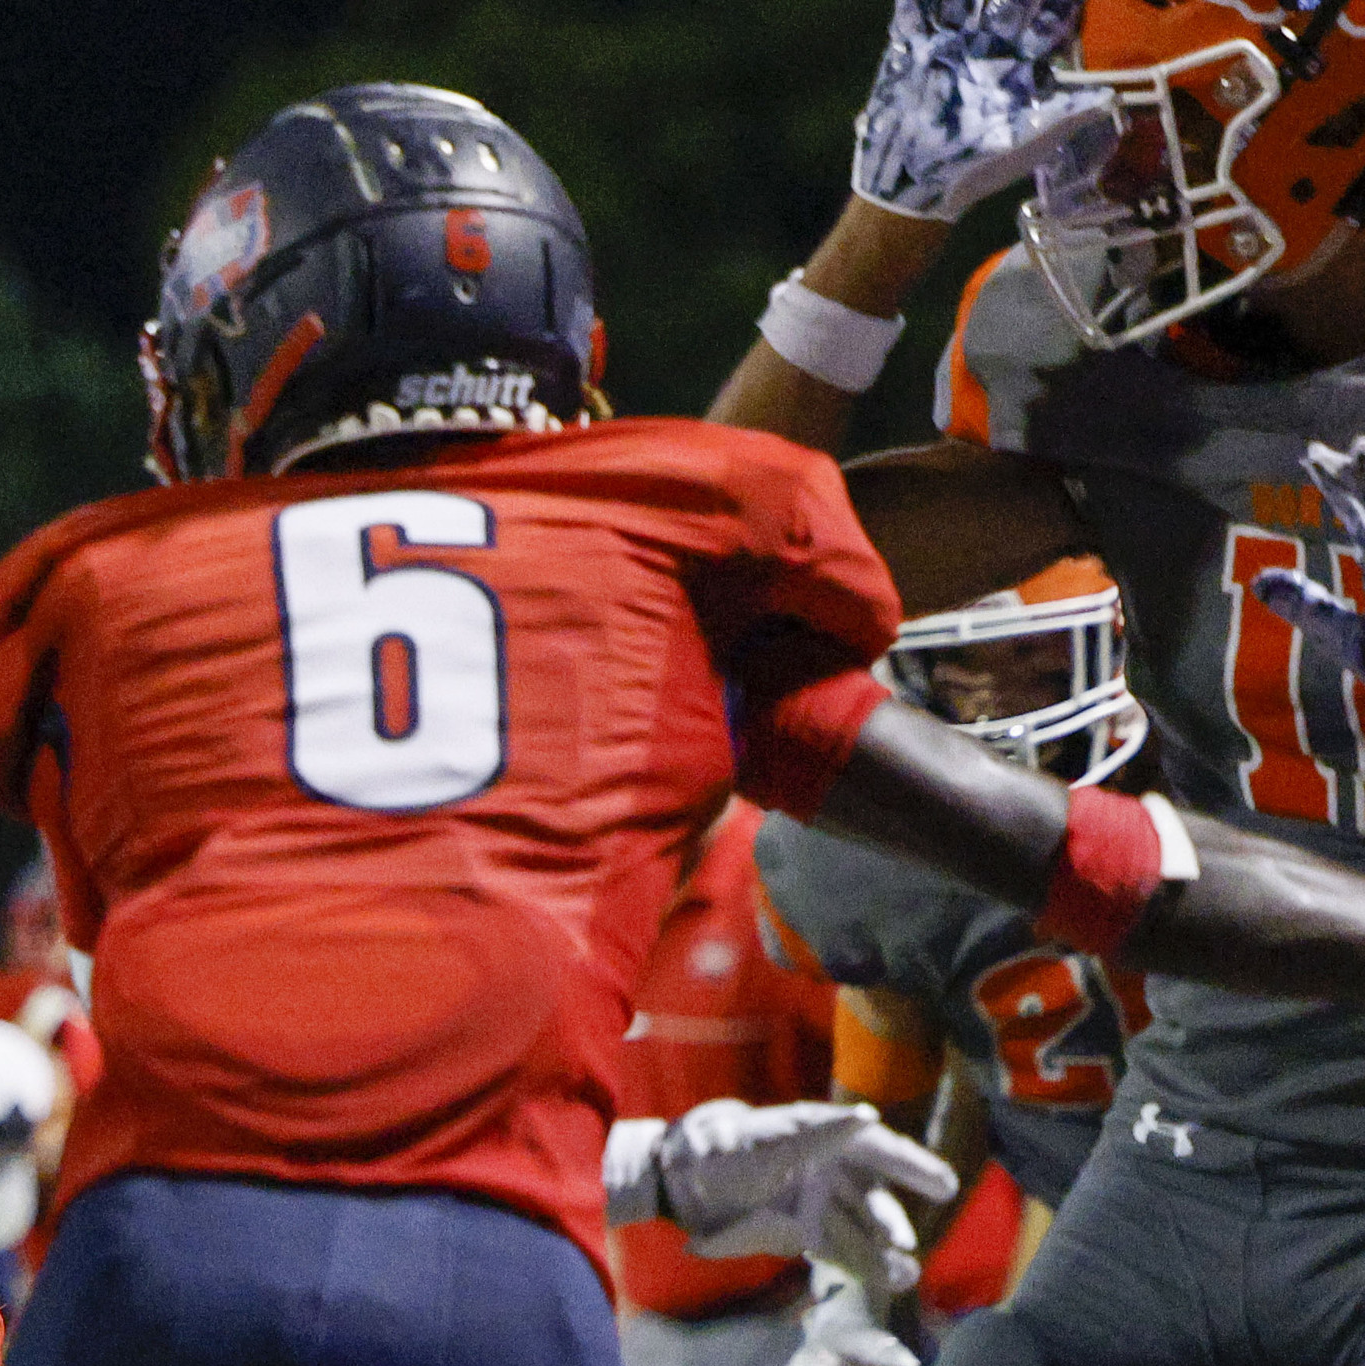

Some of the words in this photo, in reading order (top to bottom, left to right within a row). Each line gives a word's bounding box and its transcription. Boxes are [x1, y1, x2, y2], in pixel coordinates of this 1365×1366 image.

[445, 208, 493, 273] 6
[272, 489, 510, 814] 6
[971, 947, 1157, 1113] 2
